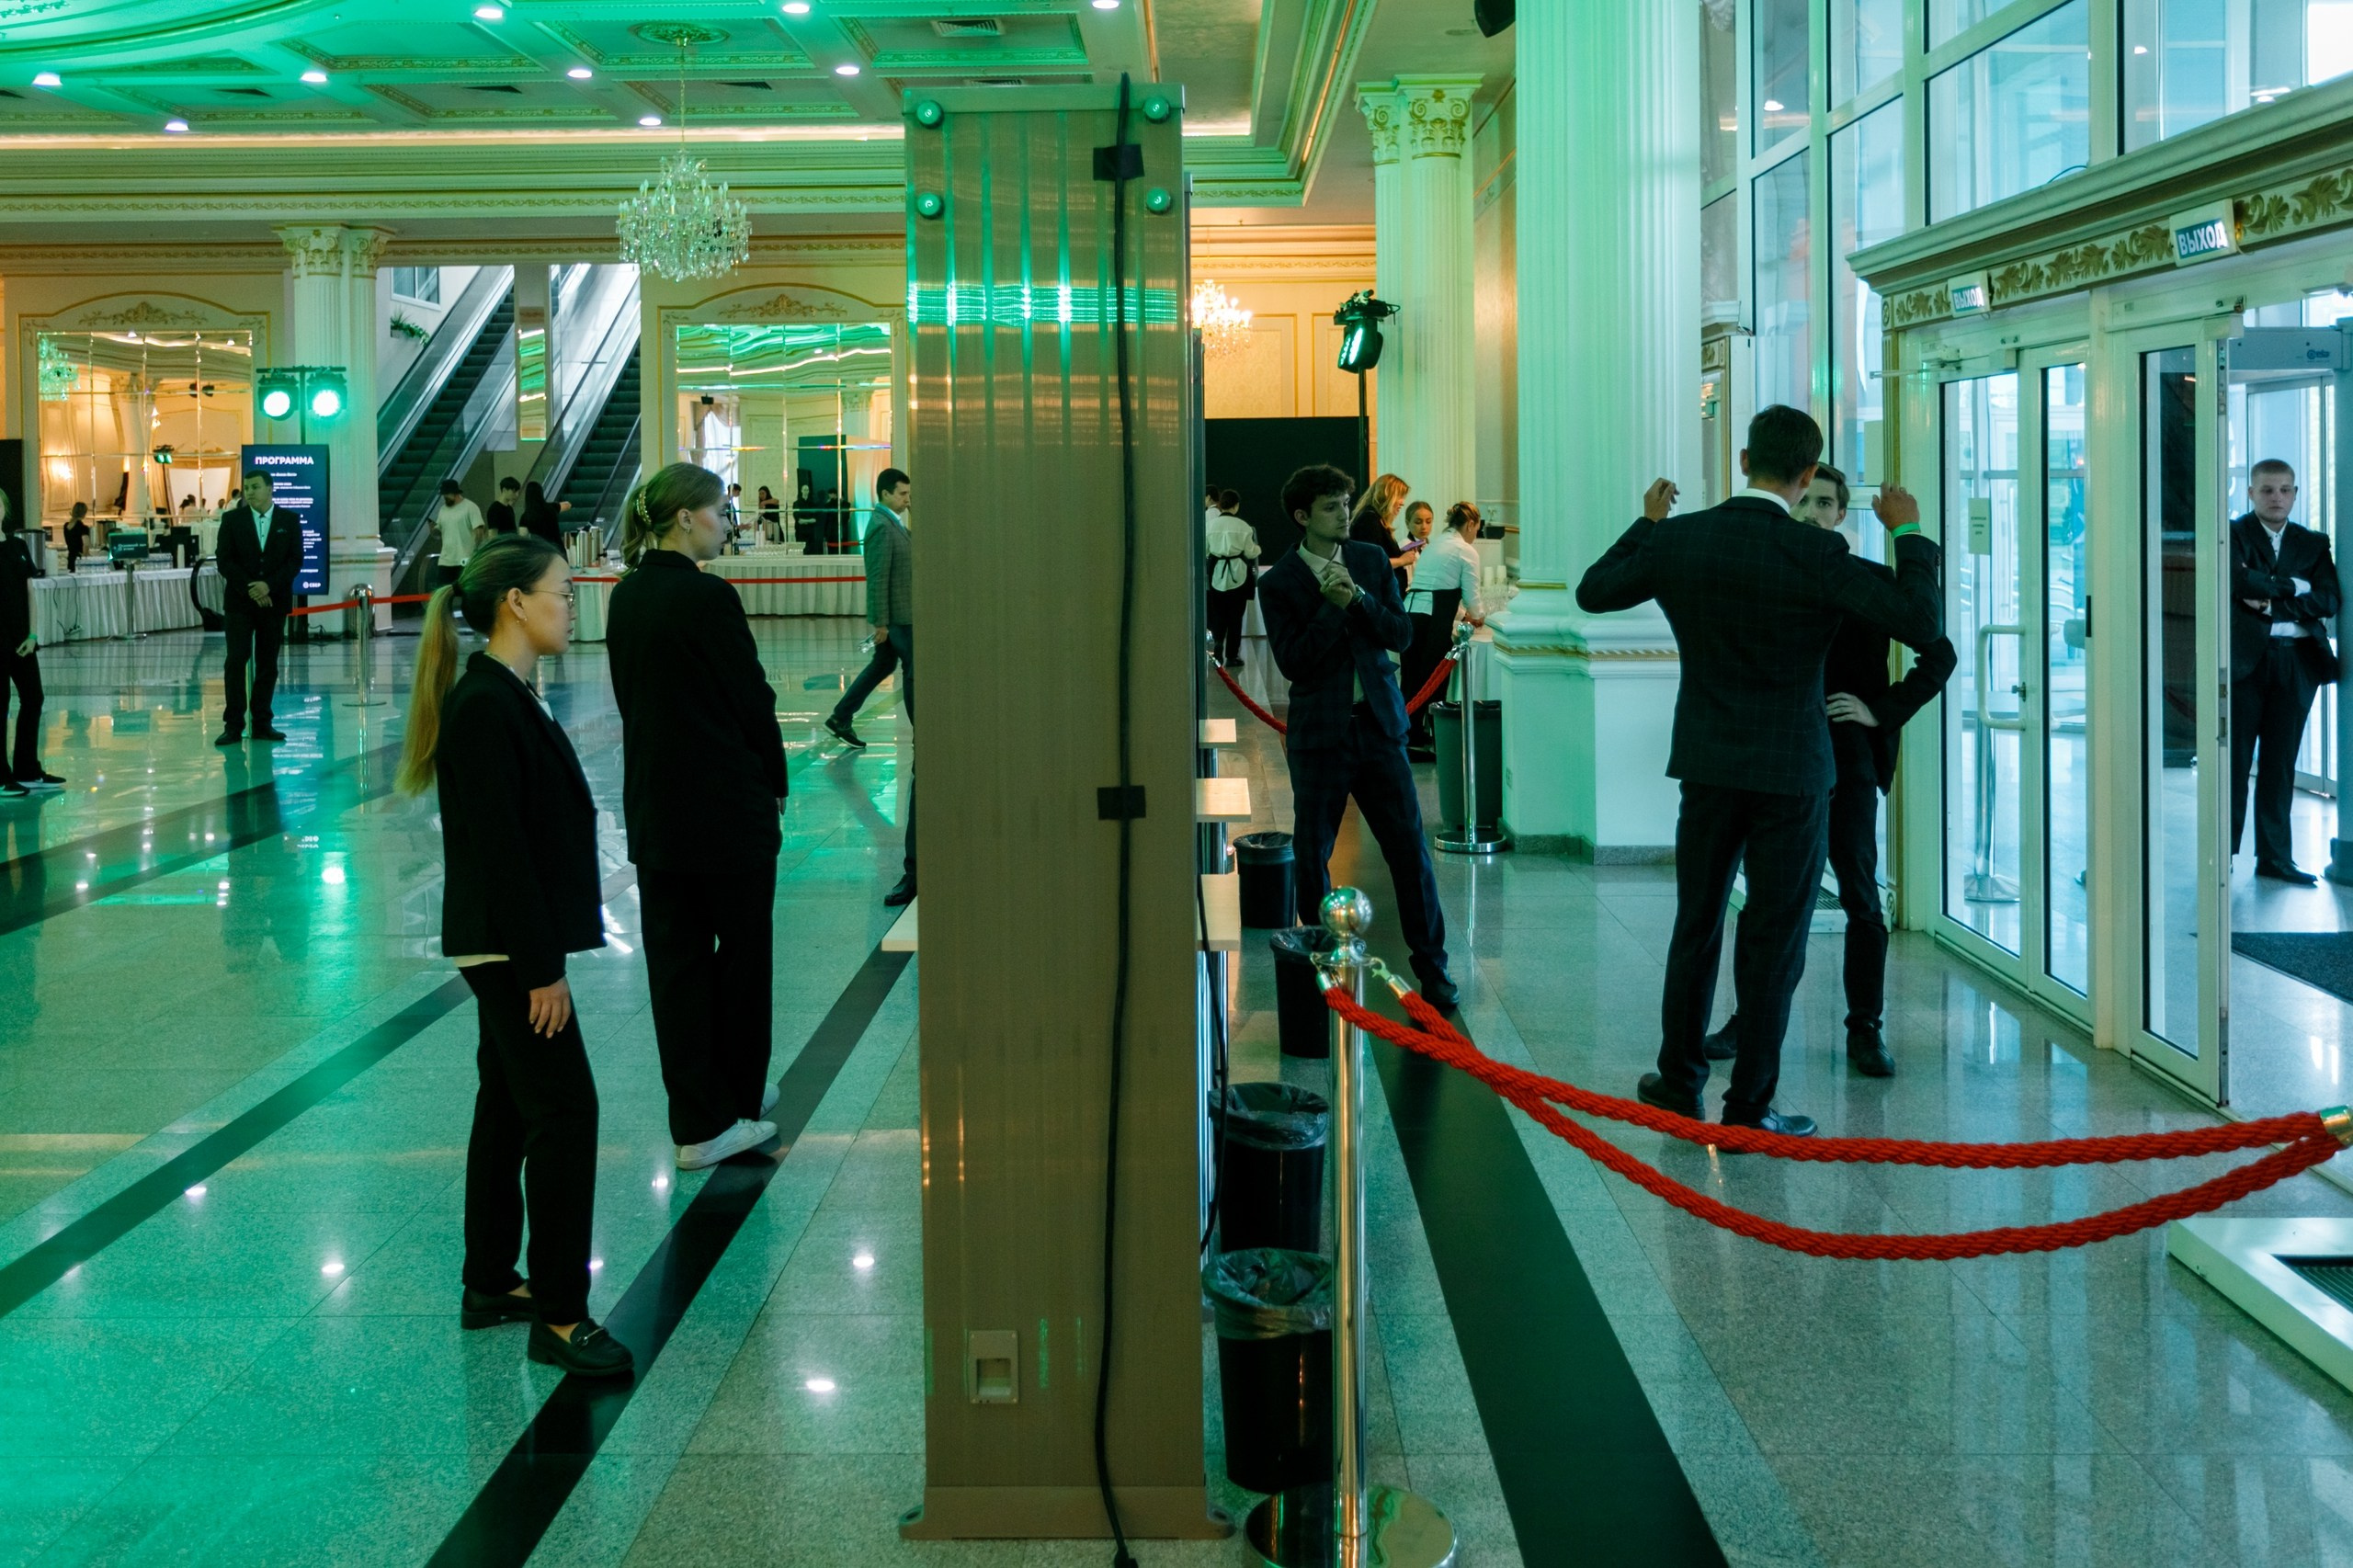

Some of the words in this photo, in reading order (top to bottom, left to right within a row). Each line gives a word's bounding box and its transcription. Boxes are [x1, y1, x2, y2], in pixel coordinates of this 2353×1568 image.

[2178, 222, 2228, 256] ВЫХОД
[1953, 287, 1984, 309] ВЫХОД
[255, 456, 314, 465] ПРОГРАММА
